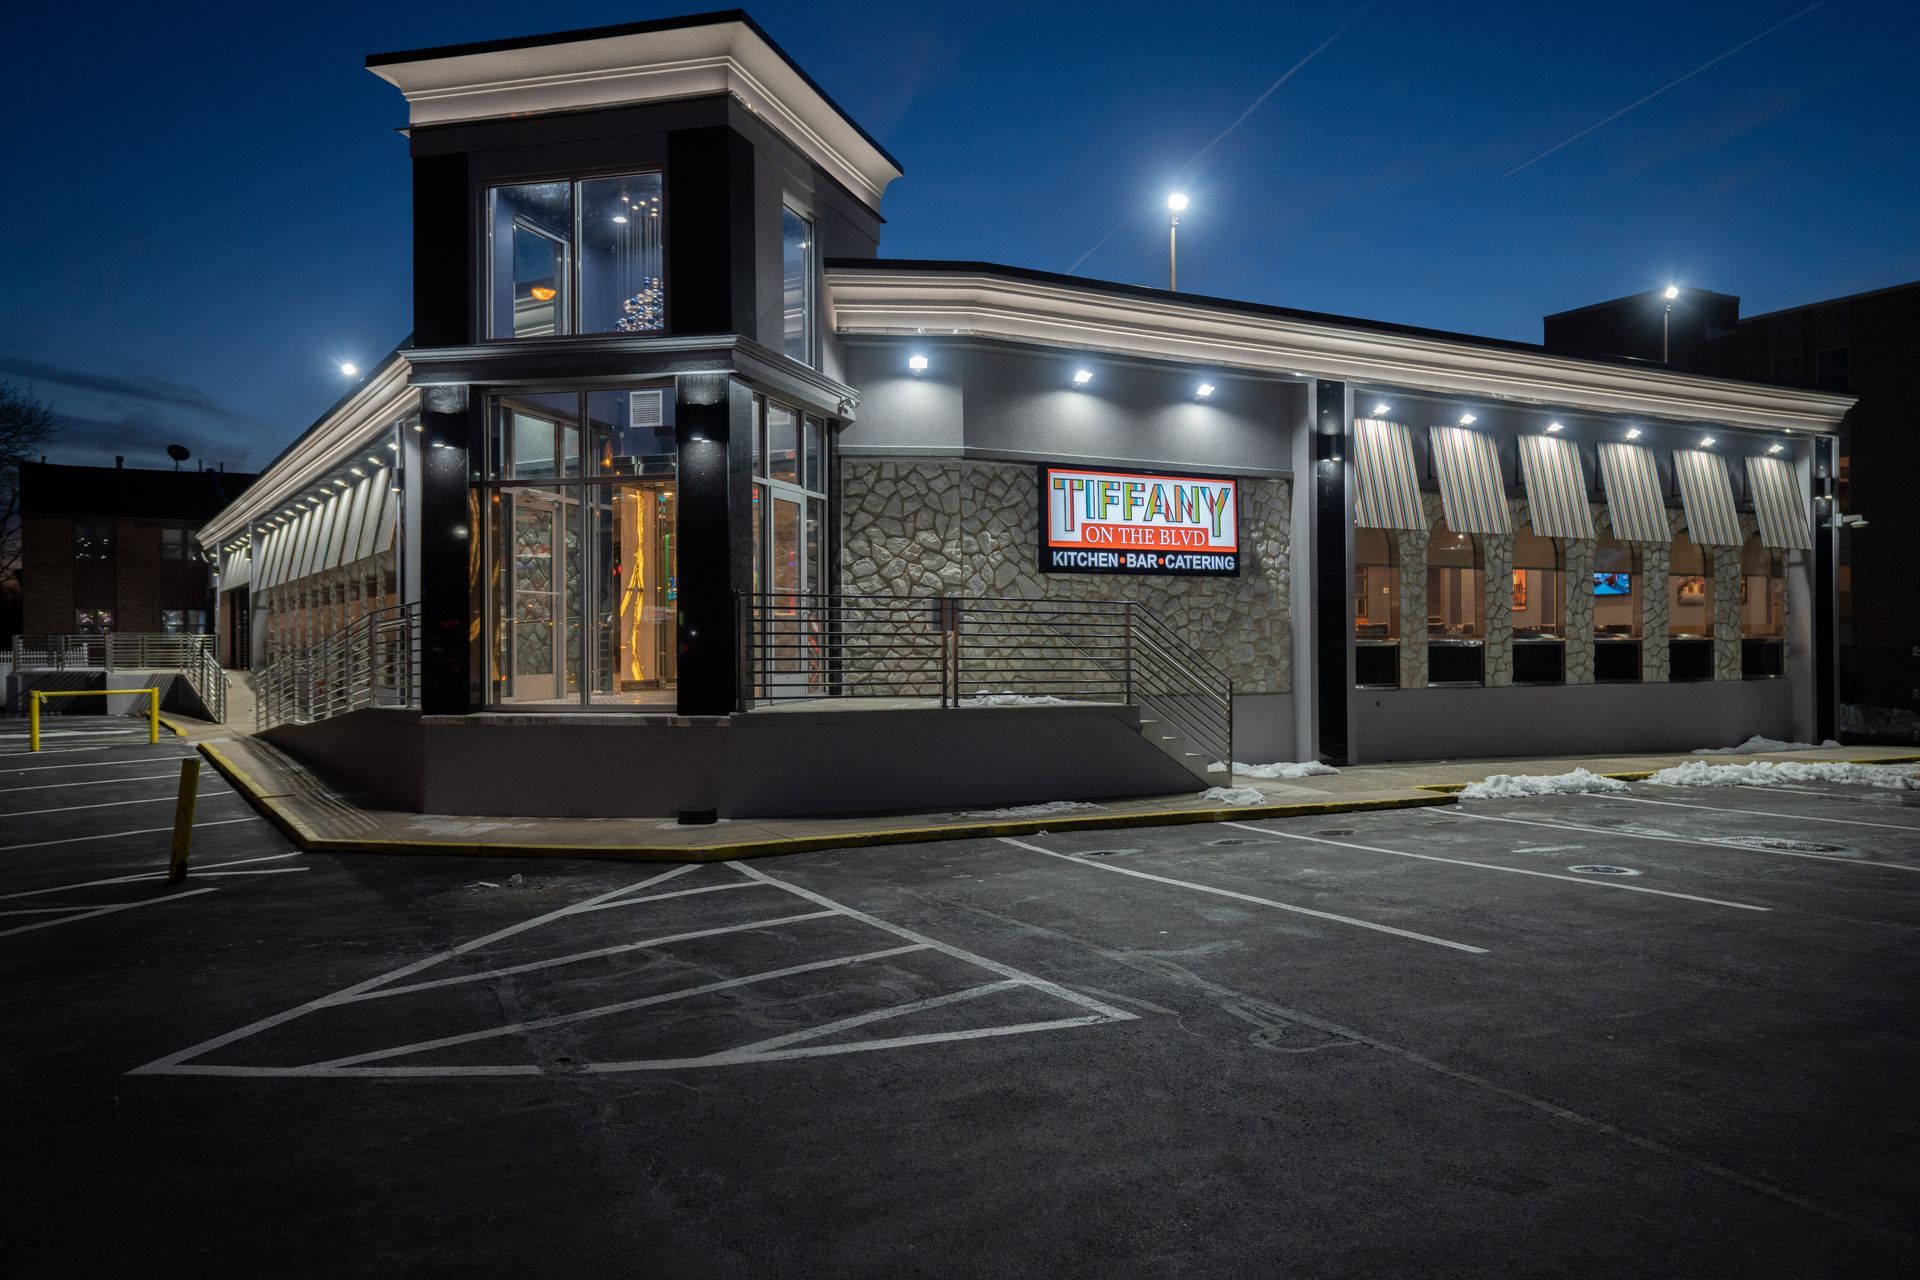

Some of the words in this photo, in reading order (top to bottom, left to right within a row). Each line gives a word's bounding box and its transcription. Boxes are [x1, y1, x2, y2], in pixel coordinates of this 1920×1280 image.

[1053, 477, 1231, 537] TIFFANY
[1085, 526, 1116, 543] ON
[1117, 527, 1154, 545] THE
[1159, 528, 1206, 546] BLVD
[1052, 551, 1118, 568] KITCHEN
[1126, 553, 1158, 569] BAR
[1165, 555, 1235, 570] CATERING
